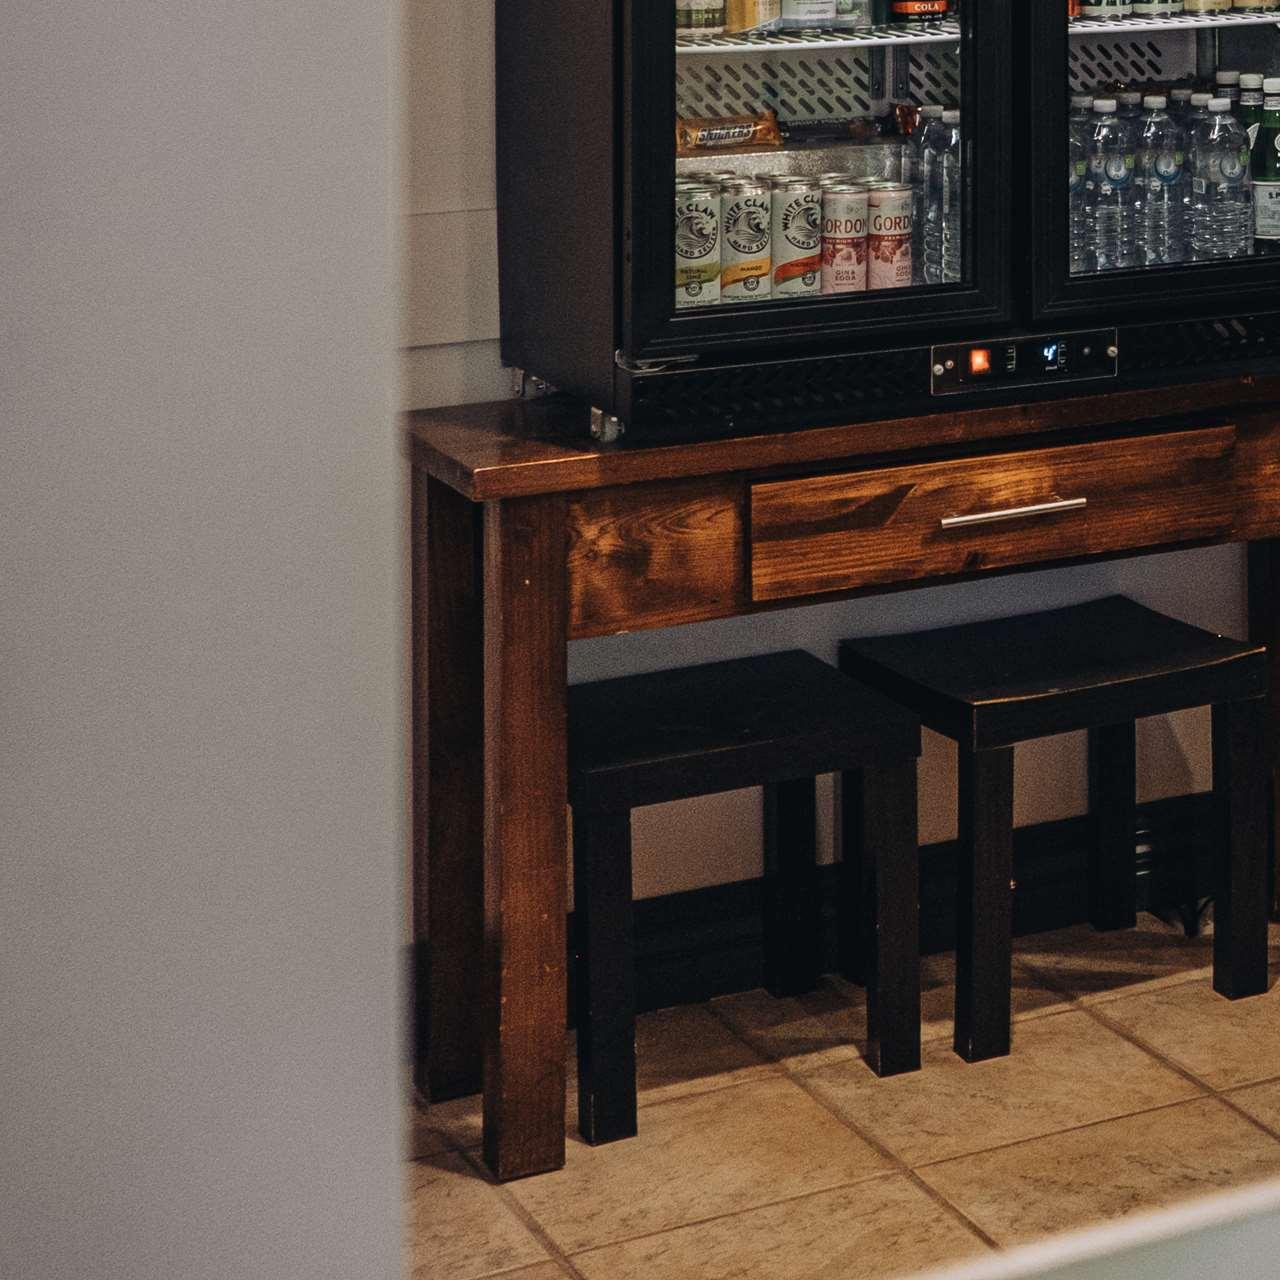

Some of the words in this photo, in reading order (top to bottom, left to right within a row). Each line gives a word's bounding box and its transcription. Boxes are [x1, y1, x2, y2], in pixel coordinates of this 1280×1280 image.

[913, 3, 940, 12] COLA
[724, 202, 743, 235] WHITE
[782, 198, 802, 232] WHITE
